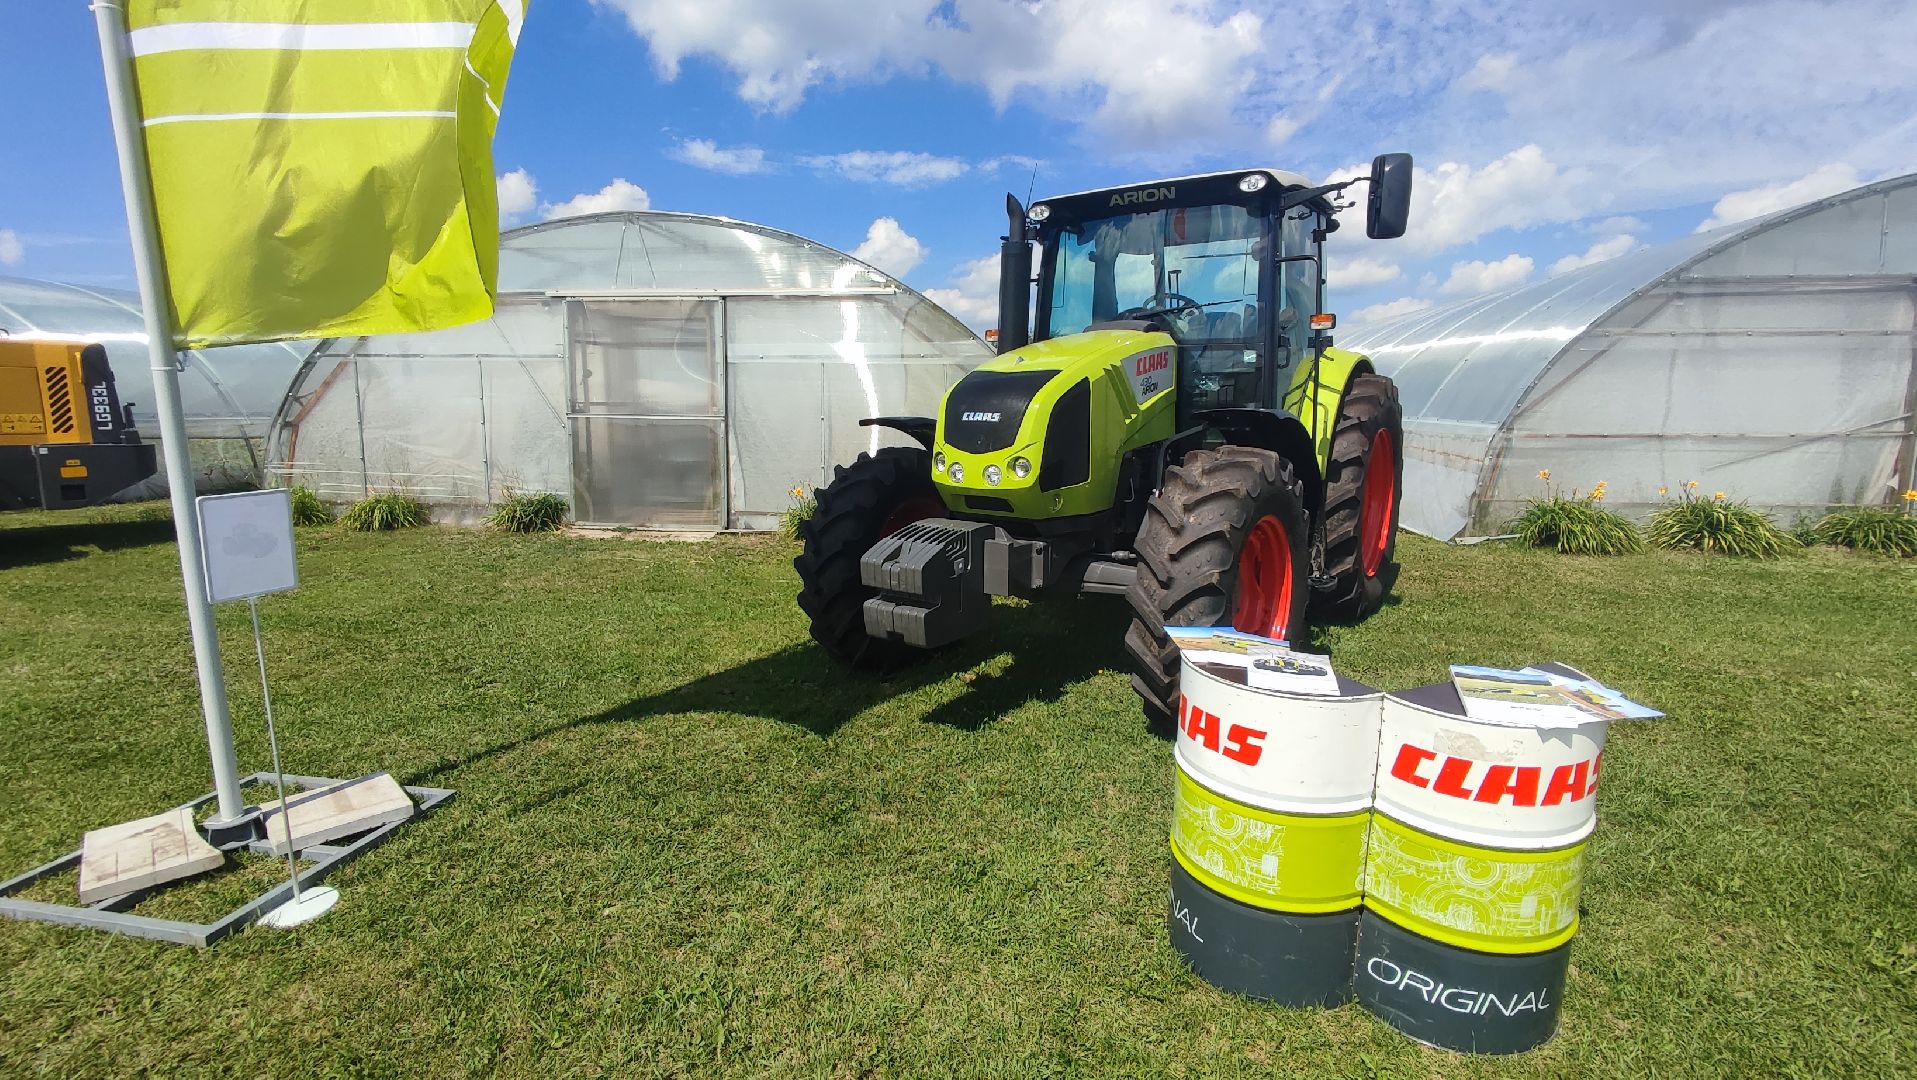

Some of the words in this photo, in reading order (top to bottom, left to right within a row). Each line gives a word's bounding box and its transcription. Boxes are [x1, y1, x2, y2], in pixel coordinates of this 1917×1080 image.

[1109, 186, 1176, 207] ARION
[1136, 351, 1169, 376] CLAAS
[92, 381, 113, 430] LG933L
[962, 411, 1001, 422] CLAAS
[1367, 957, 1550, 1017] ORIGINAL
